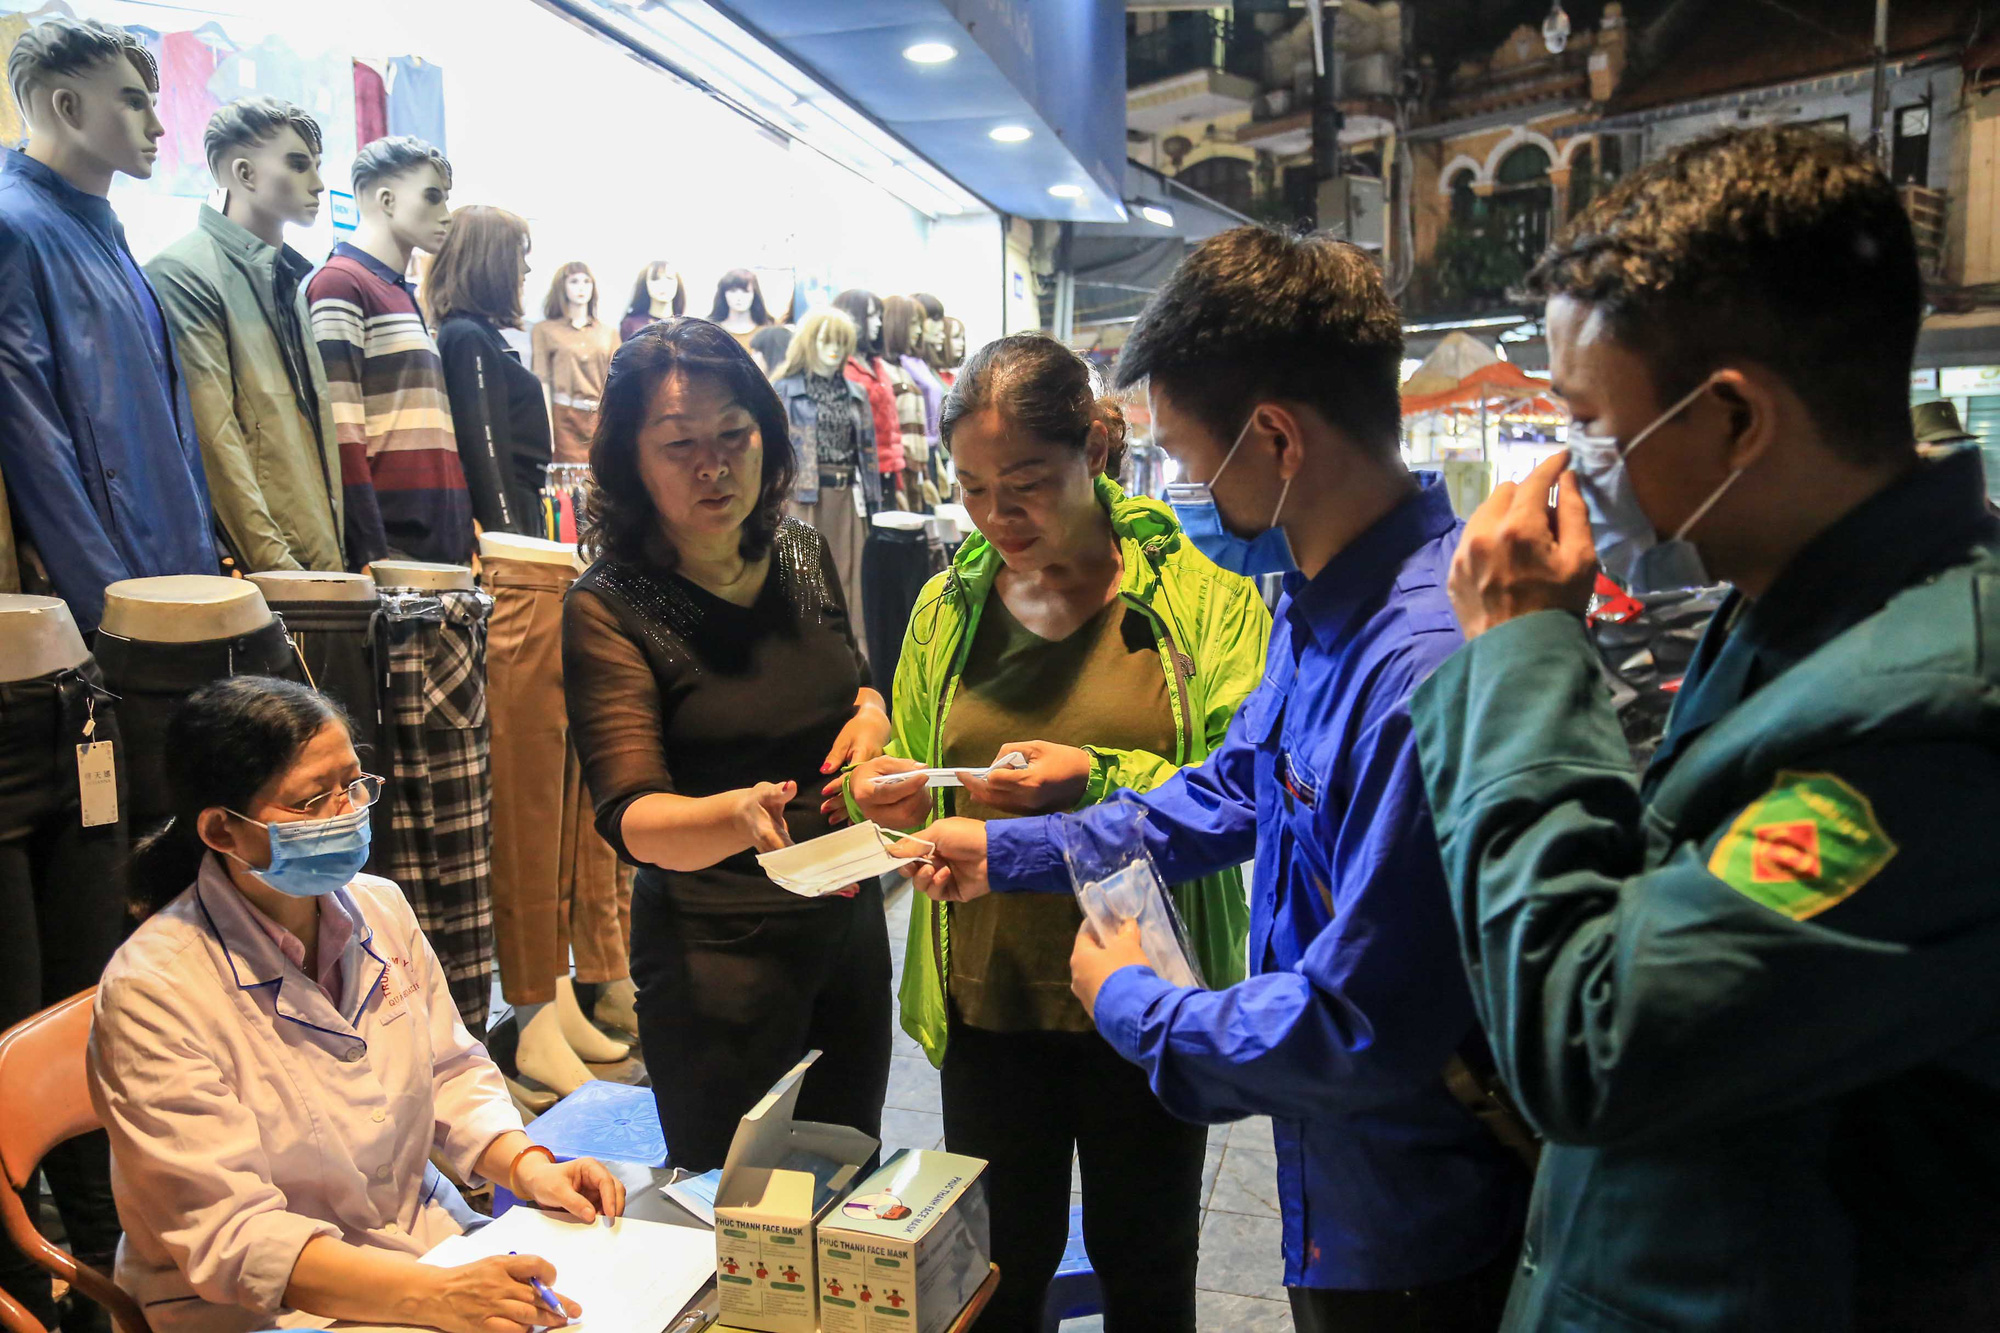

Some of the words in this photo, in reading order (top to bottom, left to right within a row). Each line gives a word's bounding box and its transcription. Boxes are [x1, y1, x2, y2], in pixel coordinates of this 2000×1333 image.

[929, 1189, 950, 1206] THANH
[917, 1205, 935, 1218] FACE
[715, 1217, 735, 1227] PHUC
[735, 1220, 761, 1231] THANH
[762, 1224, 780, 1234] FACE
[781, 1226, 803, 1236] MASK
[903, 1218, 922, 1233] MASK
[819, 1237, 839, 1248] PHUC
[839, 1240, 866, 1252] THANH
[867, 1245, 885, 1256] FACE
[886, 1248, 909, 1259] MASK
